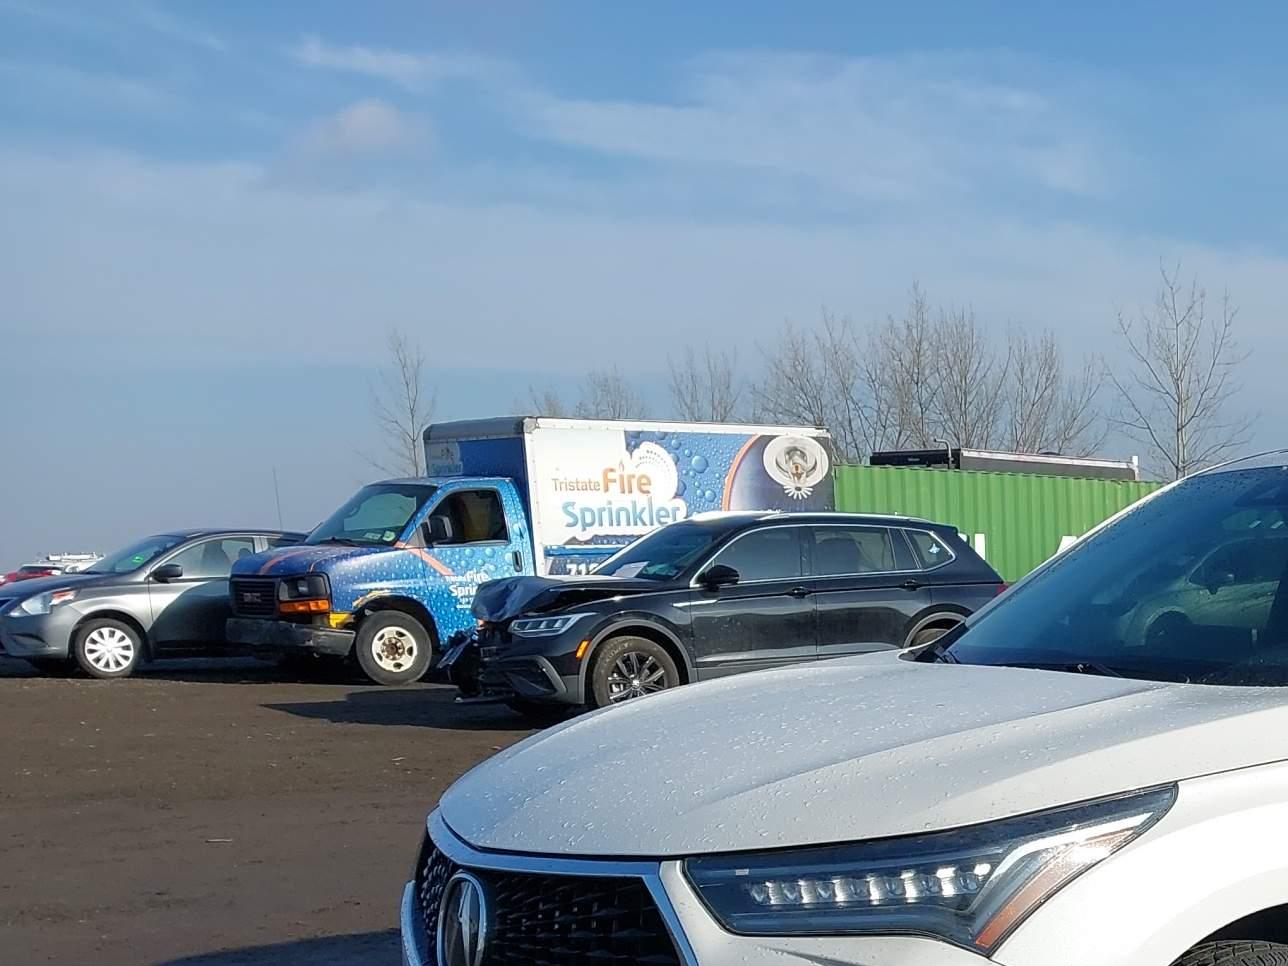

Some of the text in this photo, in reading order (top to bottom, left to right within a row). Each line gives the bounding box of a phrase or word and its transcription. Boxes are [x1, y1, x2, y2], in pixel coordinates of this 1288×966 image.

[551, 461, 652, 494] Tristate Fire
[562, 497, 680, 532] Sprinkler
